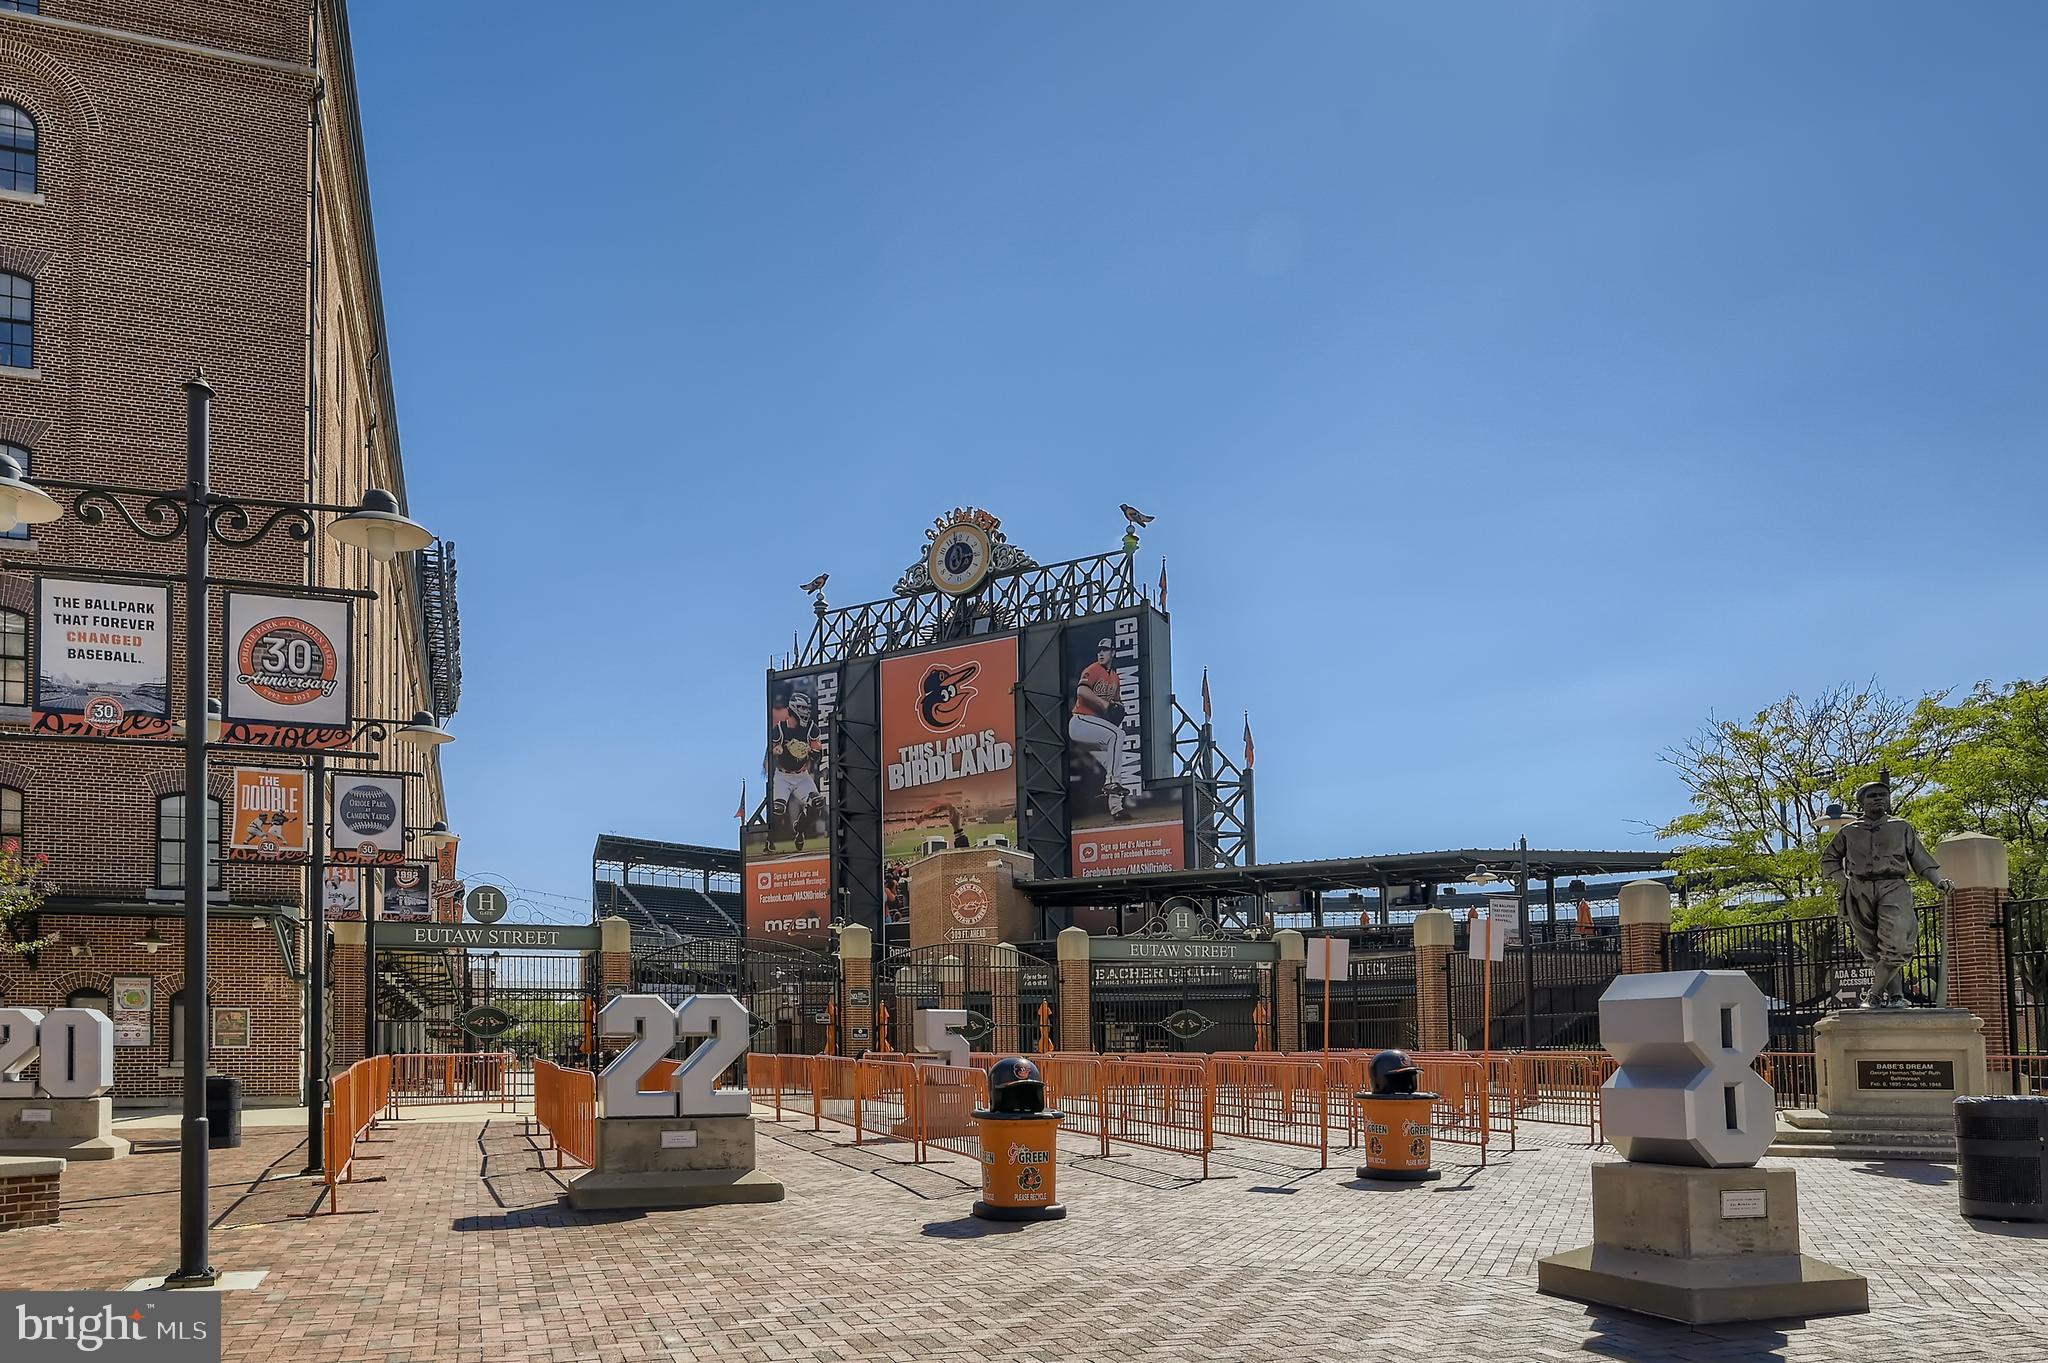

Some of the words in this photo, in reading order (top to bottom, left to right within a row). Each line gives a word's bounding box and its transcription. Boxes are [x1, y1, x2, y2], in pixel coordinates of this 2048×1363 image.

[53, 596, 80, 609] THE
[85, 599, 155, 614] BALLPARK
[54, 613, 88, 626] THAT
[93, 616, 154, 631] FOREVER
[66, 631, 142, 647] CHANGED
[242, 631, 258, 663] ORIOLE
[257, 620, 278, 635] PARK
[288, 620, 324, 642] CAMDEN
[322, 641, 333, 671] YARDS
[1115, 617, 1138, 659] GET
[67, 648, 143, 664] BASEBALL.
[262, 636, 312, 675] 30
[237, 672, 337, 697] Anniversary
[1116, 665, 1140, 728] MORE
[94, 705, 113, 718] 30
[33, 714, 171, 736] Orles
[225, 724, 351, 748] Orioles
[898, 742, 933, 763] THIS
[937, 735, 977, 756] LAND
[980, 729, 995, 746] IS
[888, 743, 1013, 791] BIRDLAND
[1120, 734, 1142, 797] GAME
[259, 775, 280, 786] THE
[241, 785, 298, 813] DOUBLE
[349, 799, 370, 808] ORIOLE
[371, 800, 387, 808] PARK
[346, 811, 370, 820] CAMDEN
[371, 812, 390, 821] YARDS
[262, 843, 274, 851] 30
[362, 845, 373, 854] 30
[1100, 843, 1111, 852] Sign
[1112, 842, 1119, 851] up
[1119, 841, 1127, 849] for
[1136, 840, 1151, 848] Alerts
[1152, 839, 1162, 847] and
[1100, 852, 1114, 860] more
[1114, 851, 1120, 859] on
[1121, 849, 1144, 858] Facebook
[327, 867, 355, 882] 131
[395, 870, 419, 879] 1992
[476, 892, 497, 911] H
[765, 918, 820, 931] masn
[1175, 912, 1190, 928] H
[414, 928, 483, 943] EUTAW
[488, 930, 560, 945] STREET
[1130, 944, 1180, 957] EUTAW
[1184, 945, 1237, 958] STREET
[1357, 962, 1387, 976] DECK
[1834, 970, 1849, 979] ADA
[1850, 969, 1858, 978] &
[1839, 978, 1875, 987] ACCESSIBLE
[0, 1007, 113, 1098] 20
[598, 994, 751, 1119] 22
[1599, 969, 1776, 1168] 8
[1410, 1126, 1429, 1136] GREEN
[1018, 1152, 1048, 1163] GREEN
